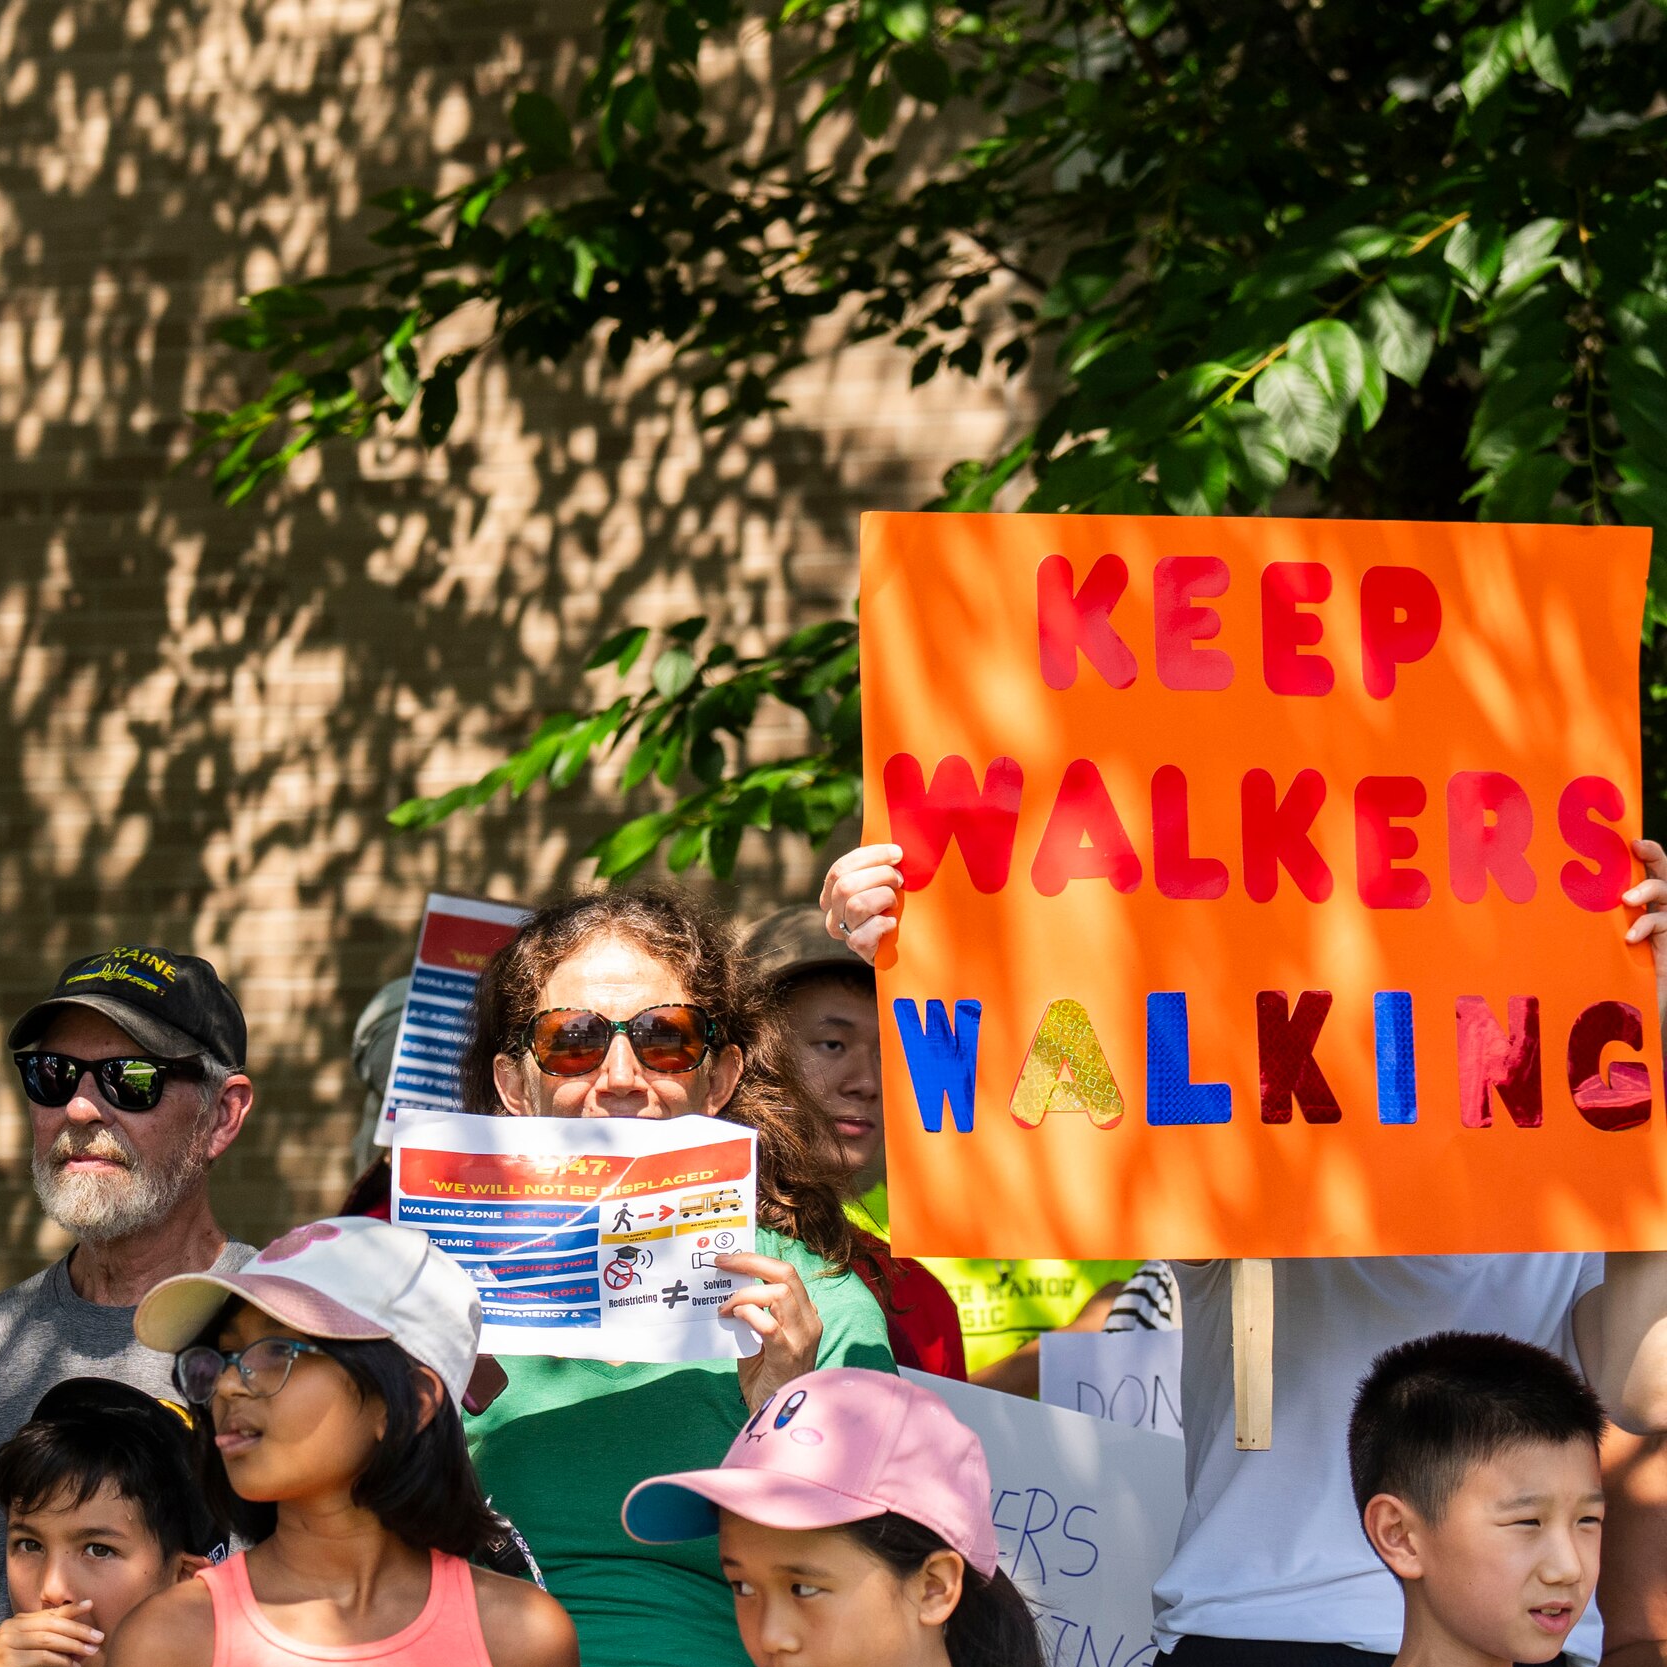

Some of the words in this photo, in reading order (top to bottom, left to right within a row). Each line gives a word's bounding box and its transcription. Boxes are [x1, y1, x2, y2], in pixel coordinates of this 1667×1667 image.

[1036, 553, 1443, 702] KEEP
[883, 752, 1633, 913] WALKERS
[893, 990, 1653, 1134] WALKING
[481, 1182, 524, 1195] WILL
[525, 1184, 568, 1196] NOT
[570, 1185, 597, 1197] BE
[401, 1205, 464, 1217] WALKING
[465, 1210, 502, 1219] ZONE
[703, 1279, 732, 1290] Solving
[551, 1286, 594, 1298] COSTS
[608, 1294, 658, 1308] Redistricting
